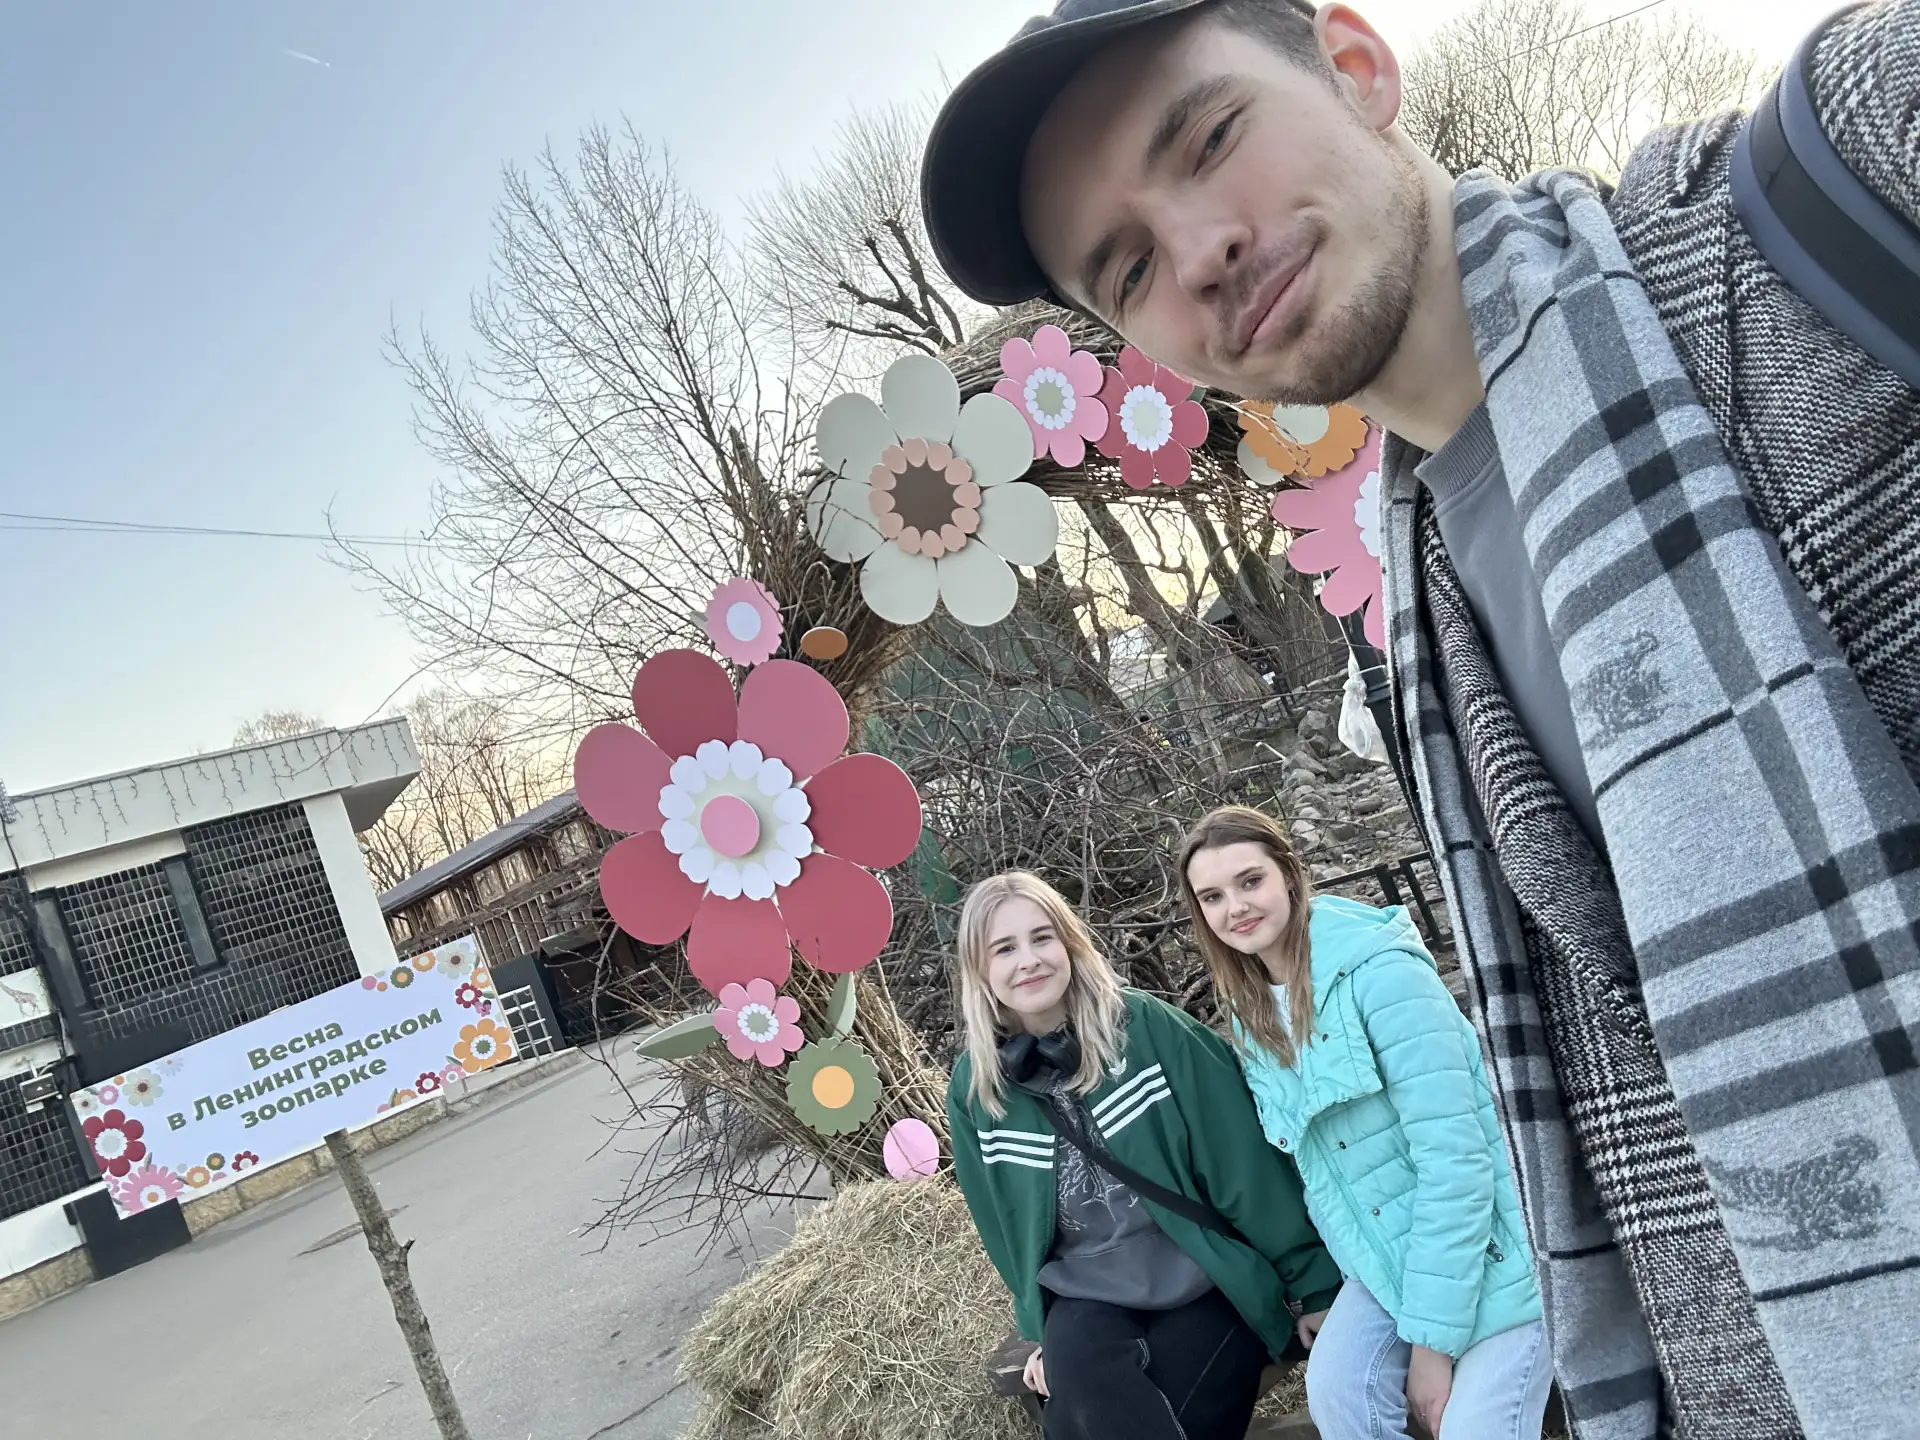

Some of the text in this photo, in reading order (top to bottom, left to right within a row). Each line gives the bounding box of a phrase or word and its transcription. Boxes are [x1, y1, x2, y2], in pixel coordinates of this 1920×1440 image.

[167, 1008, 442, 1131] в Ленинградском
[247, 1021, 343, 1070] Весна
[241, 1058, 387, 1128] зоопарке
